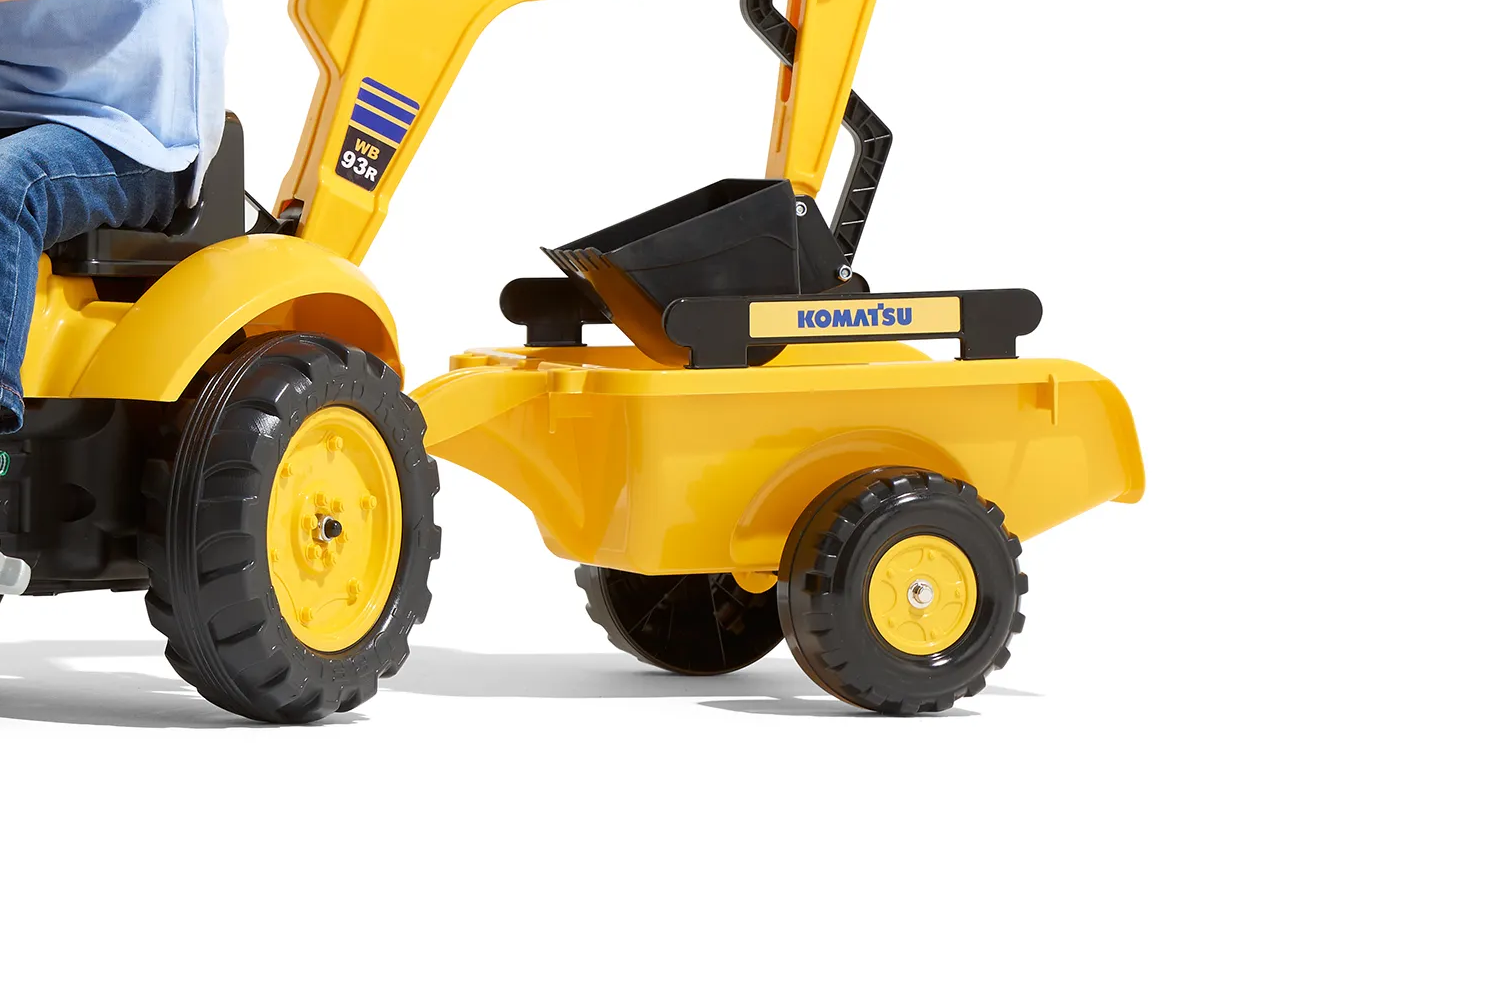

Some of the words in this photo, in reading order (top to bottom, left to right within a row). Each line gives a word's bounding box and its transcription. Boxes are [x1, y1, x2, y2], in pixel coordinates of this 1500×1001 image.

[354, 137, 381, 161] WB
[340, 150, 378, 182] 93R
[797, 302, 913, 329] KOMATSU
